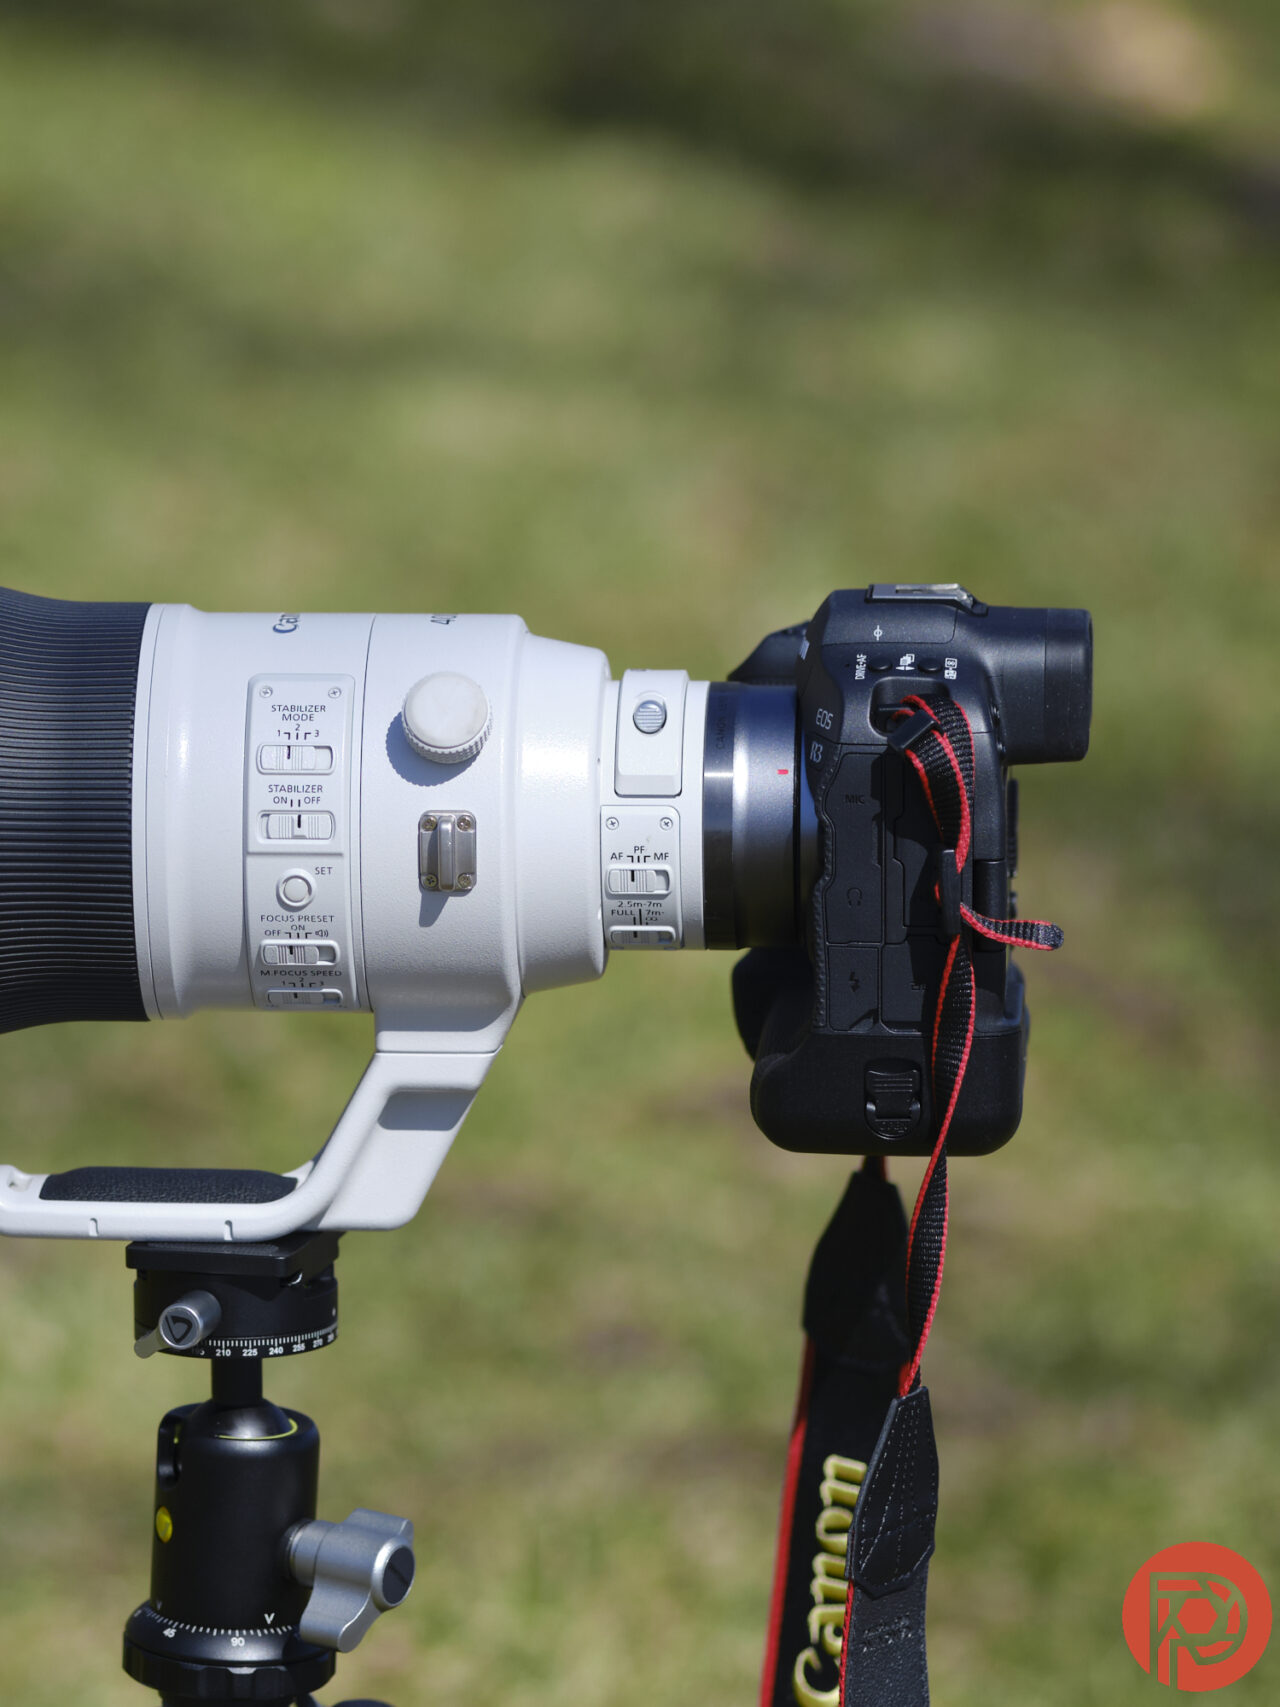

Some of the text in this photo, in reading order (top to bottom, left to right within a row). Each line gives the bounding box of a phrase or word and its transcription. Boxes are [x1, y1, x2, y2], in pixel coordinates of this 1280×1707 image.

[271, 704, 326, 713] STABILIZER
[281, 713, 315, 722] MODE
[815, 708, 834, 730] EOS
[295, 723, 300, 732] 2
[314, 729, 320, 738] 3
[809, 741, 823, 763] R3
[268, 784, 323, 794] STABILIZER
[273, 796, 321, 805] ON OFF
[633, 845, 646, 854] PF
[610, 852, 670, 861] AF MF
[315, 866, 333, 875] SET
[260, 914, 335, 923] FOCUS PRESET
[264, 924, 306, 937] OFF ON
[216, 1348, 231, 1357] 210
[242, 1348, 258, 1357] 225
[269, 1346, 284, 1355] 240
[792, 1453, 868, 1707] Canon
[162, 1628, 177, 1638] 45
[231, 1637, 245, 1647] 90
